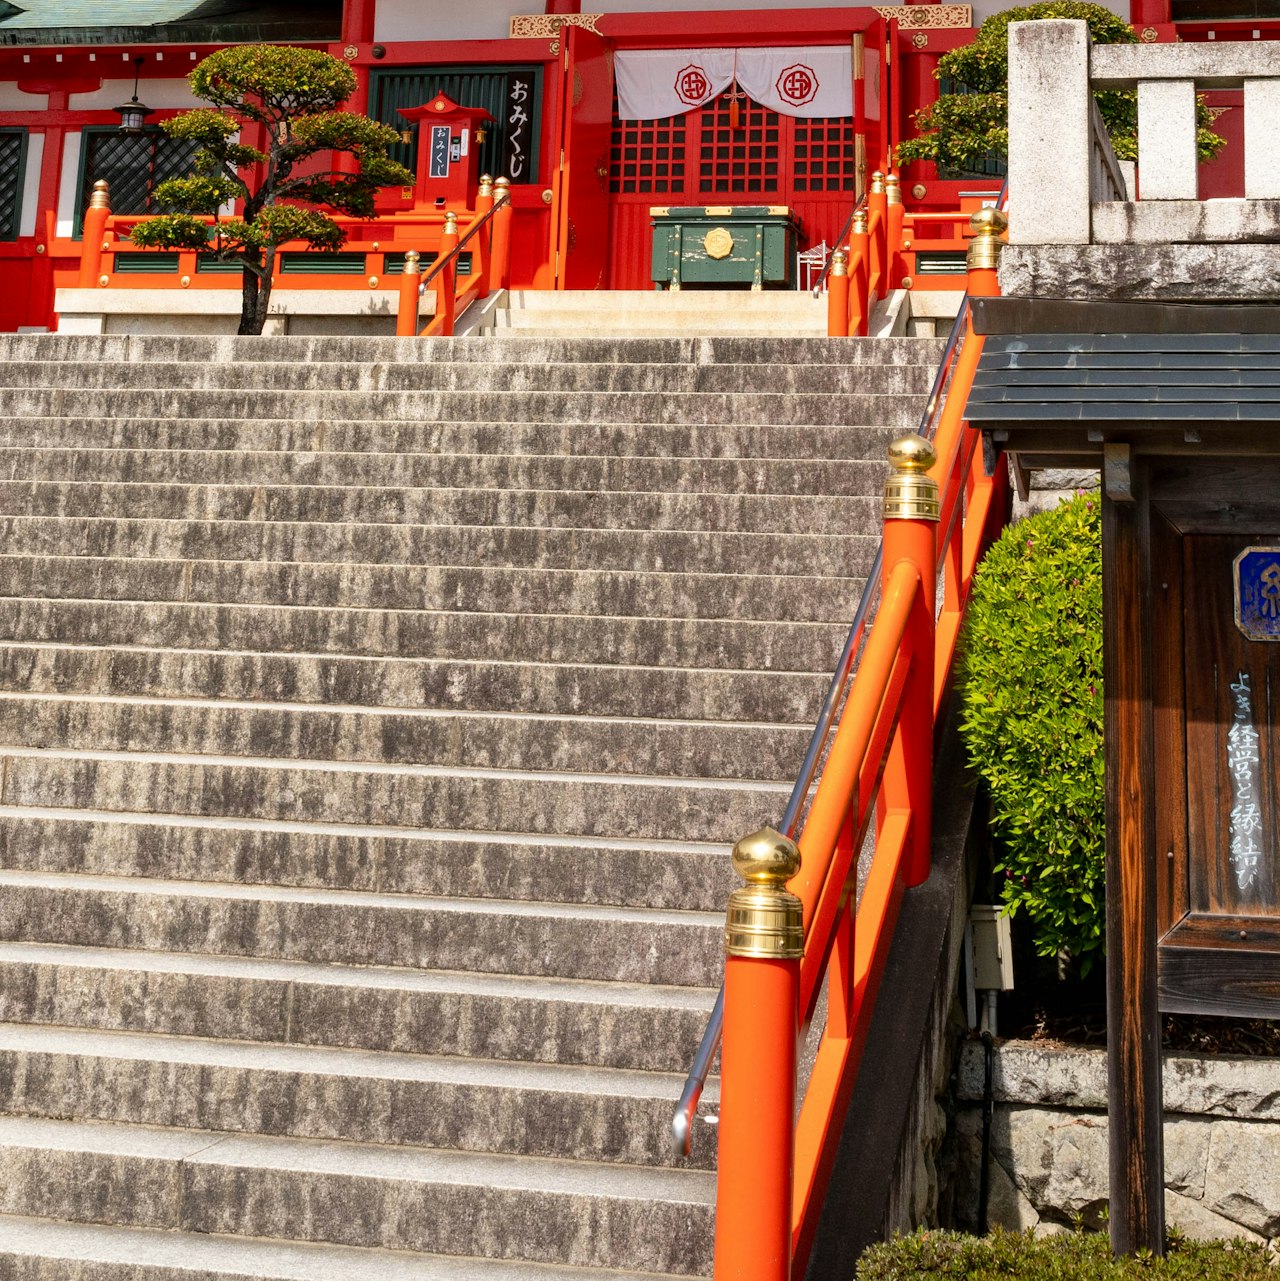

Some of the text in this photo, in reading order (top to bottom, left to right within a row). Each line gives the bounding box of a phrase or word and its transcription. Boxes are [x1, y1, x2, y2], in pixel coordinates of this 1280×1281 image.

[435, 128, 447, 176] おみくじ
[509, 80, 528, 178] おみくじ
[1227, 671, 1263, 890] よき経営と縁結び
